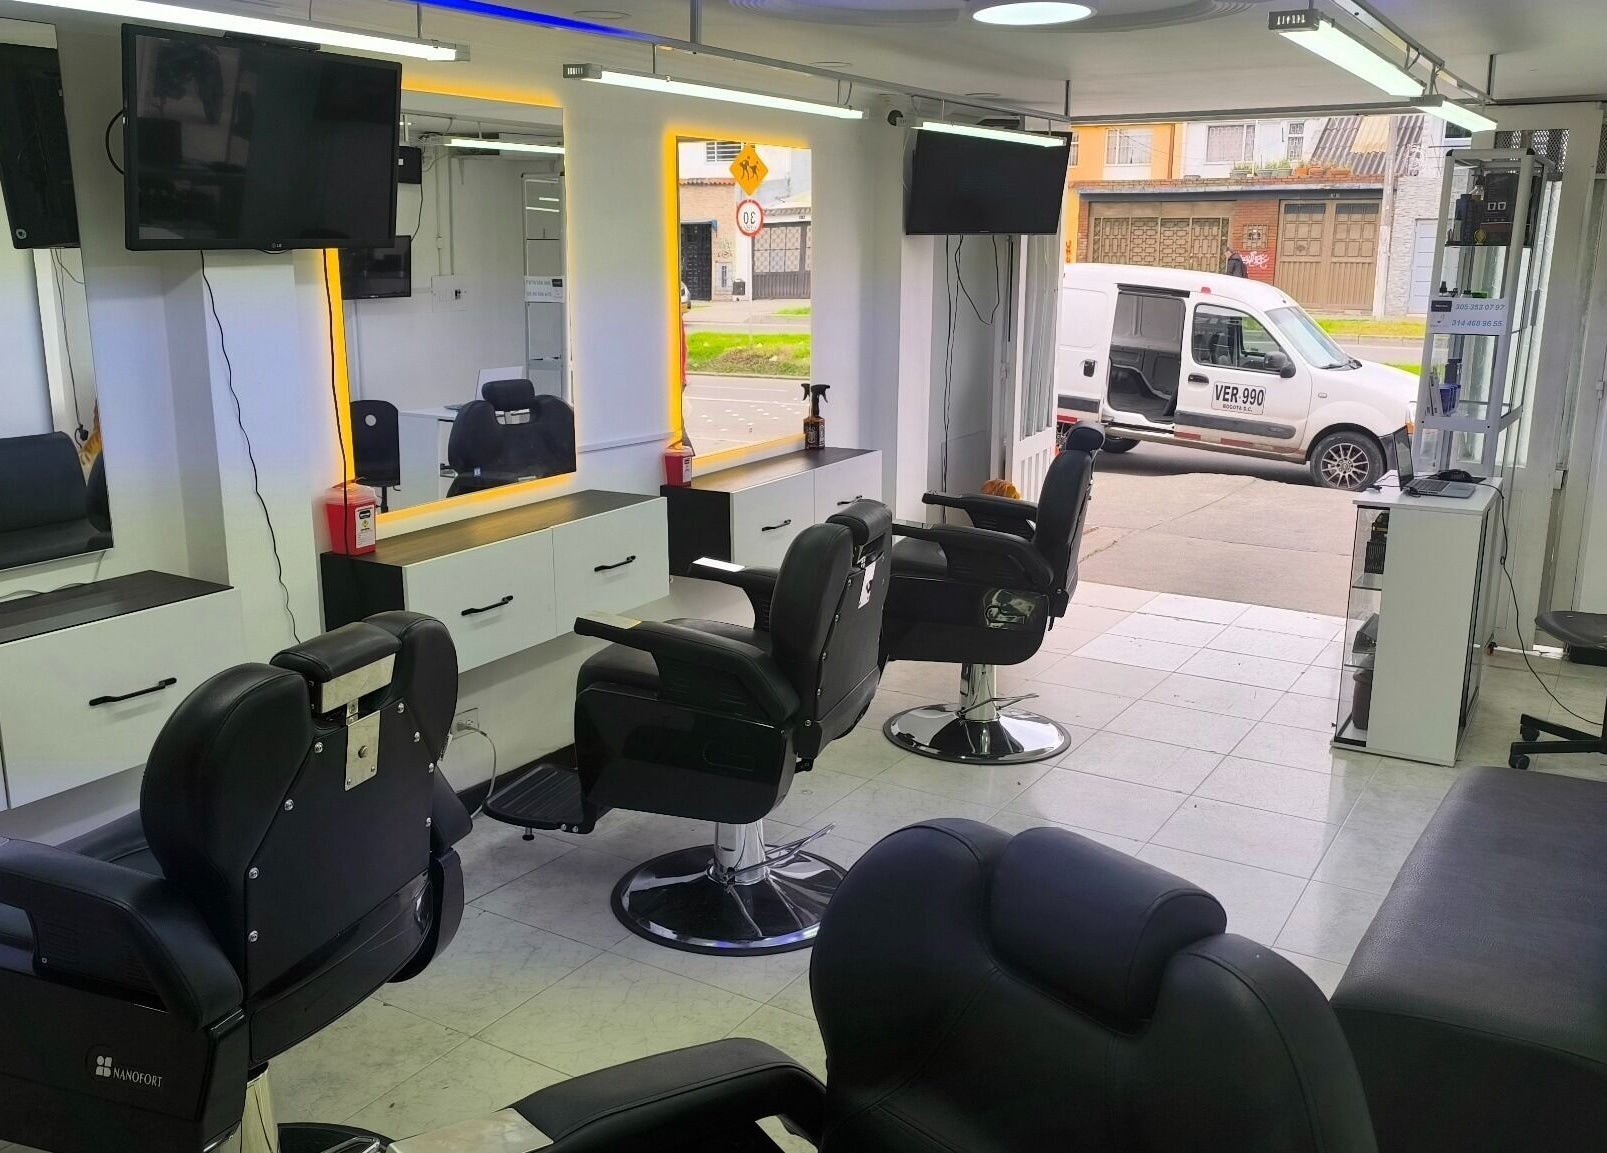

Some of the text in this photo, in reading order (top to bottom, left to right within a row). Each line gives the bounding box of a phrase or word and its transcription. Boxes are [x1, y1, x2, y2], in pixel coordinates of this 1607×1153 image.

[1455, 303, 1469, 311] 305
[1484, 303, 1494, 311] 07
[1495, 303, 1505, 311] 97
[1451, 319, 1466, 327] 314
[1215, 384, 1264, 406] VER 990
[113, 1067, 163, 1087] NANOFORT
